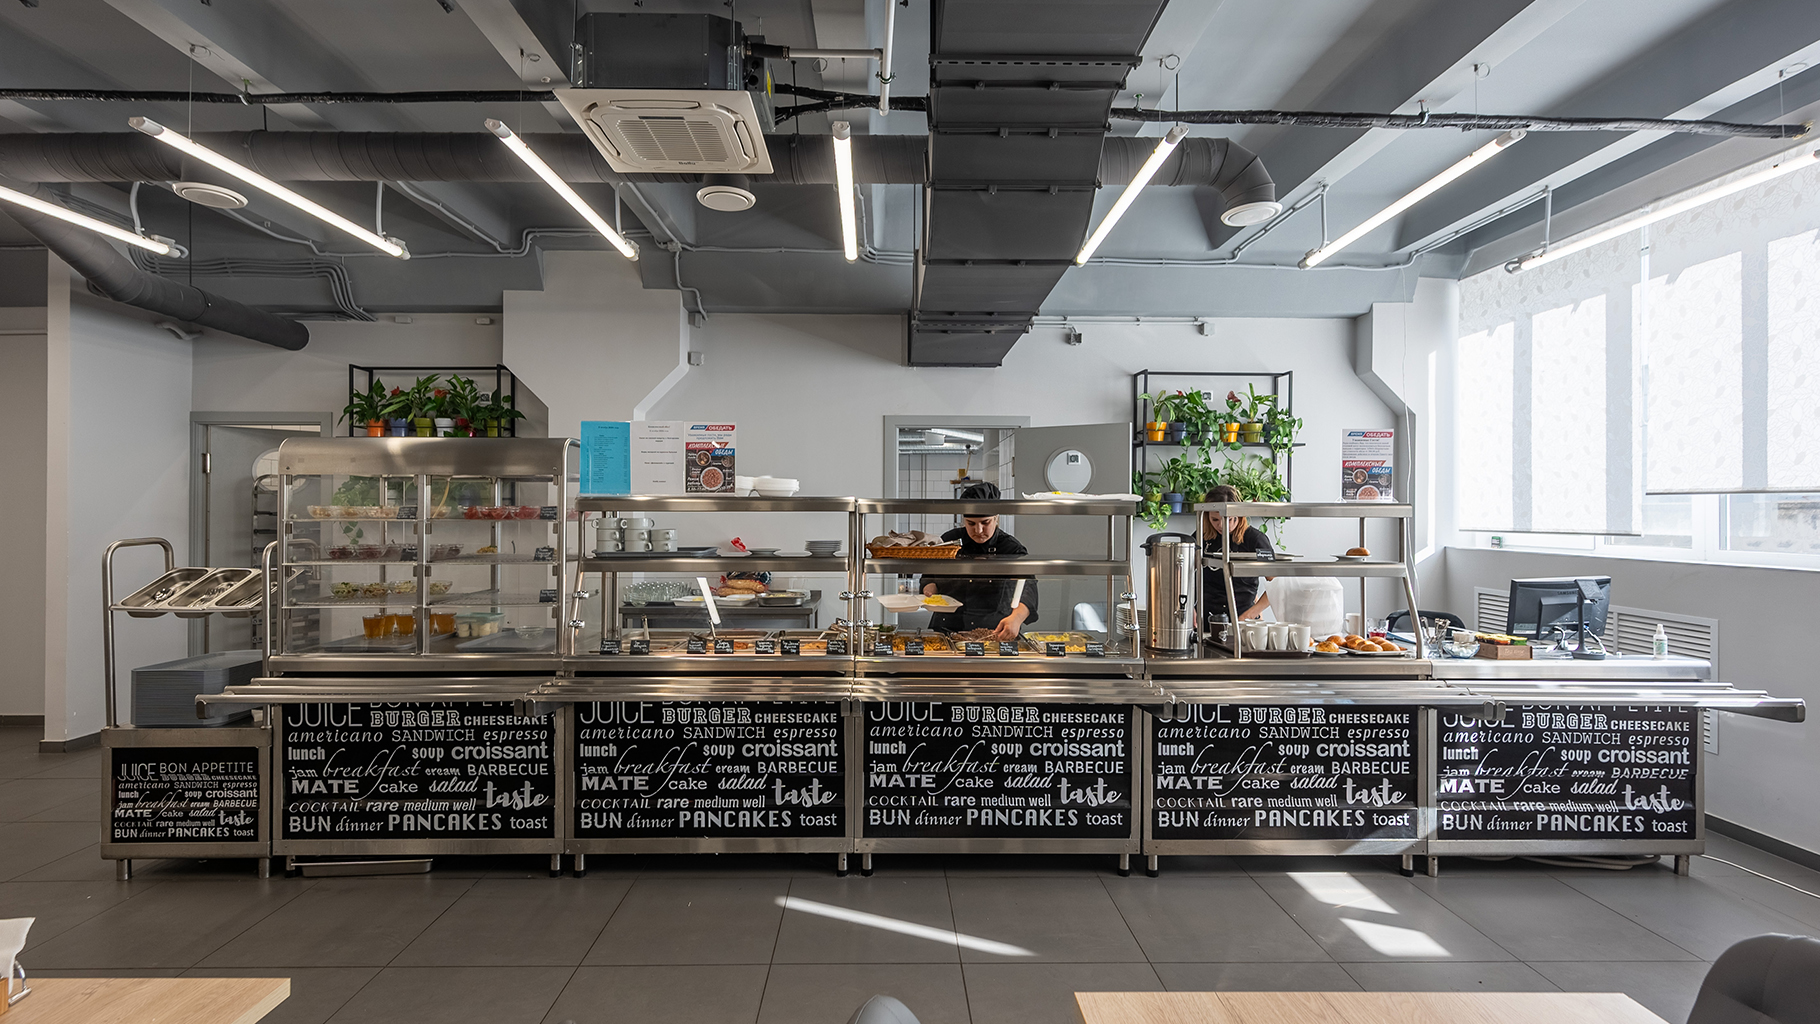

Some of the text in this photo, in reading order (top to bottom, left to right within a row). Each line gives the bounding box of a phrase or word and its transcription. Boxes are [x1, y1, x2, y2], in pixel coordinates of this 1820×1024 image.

[370, 710, 461, 727] BURGER
[662, 707, 837, 724] BURGER CHEESECAKE
[951, 706, 1125, 724] BURGER CHEESECAKE
[1238, 707, 1410, 724] BURGER CHEESECAKE
[1522, 712, 1608, 730] BURGER
[1610, 720, 1690, 732] CHEESECAKE
[288, 729, 548, 743] americano SANDWICH espresso
[580, 726, 837, 741] americano SANDWICH espresso
[870, 723, 1125, 741] americano SANDWICH espresso
[1158, 725, 1410, 741] americano SANDWICH espresso
[1443, 730, 1690, 748] americano SANDWICH espresso
[288, 741, 549, 762] lunch soup croissant
[580, 739, 838, 759] lunch soup croissant
[869, 738, 1125, 758] lunch soup croissant
[1157, 739, 1411, 759] lunch soup croissant
[1443, 745, 1690, 765] lunch soup croissant
[159, 762, 187, 773] BON
[191, 762, 254, 773] APPETITE
[288, 744, 549, 801] jam breakfast cream BARBECUE
[580, 741, 838, 798] jam breakfast cream BARBECUE
[869, 739, 1124, 796] jam breakfast cream BARBECUE
[1157, 740, 1410, 797] jam breakfast cream BARBECUE
[1440, 746, 1689, 801] jam breakfast BARBECUE
[118, 788, 258, 799] lunch soup croissant
[222, 782, 258, 790] espresso
[291, 776, 549, 811] MATE cake salad taste
[581, 773, 837, 808] MATE cake salad taste
[869, 772, 1122, 807] MATE cake salad taste
[1156, 773, 1407, 808] MATE cake salad taste
[135, 789, 189, 821] breakfast
[213, 799, 257, 808] BARBECUE
[288, 798, 477, 813] COCKTAIL rare medium well
[580, 795, 765, 809] COCKTAIL rare medium well
[869, 793, 1051, 807] COCKTAIL rare medium well
[1156, 794, 1338, 808] COCKTAIL rare medium well
[1439, 778, 1685, 814] MATE cake salad taste
[1440, 800, 1546, 812] COCKTAIL rare
[114, 809, 152, 818] MATE
[188, 807, 219, 817] salad
[218, 809, 254, 826] taste
[289, 813, 548, 833] BUN dinner PANCAKES toast
[580, 810, 837, 829] BUN dinner PANCAKES toast
[869, 808, 1123, 826] BUN dinner PANCAKES toast
[1157, 809, 1410, 828] BUN dinner PANCAKES toast
[1442, 813, 1688, 833] BUN dinner PANCAKES toast
[114, 829, 138, 838] BUN
[139, 829, 166, 838] dinner
[168, 827, 230, 838] PANCAKES
